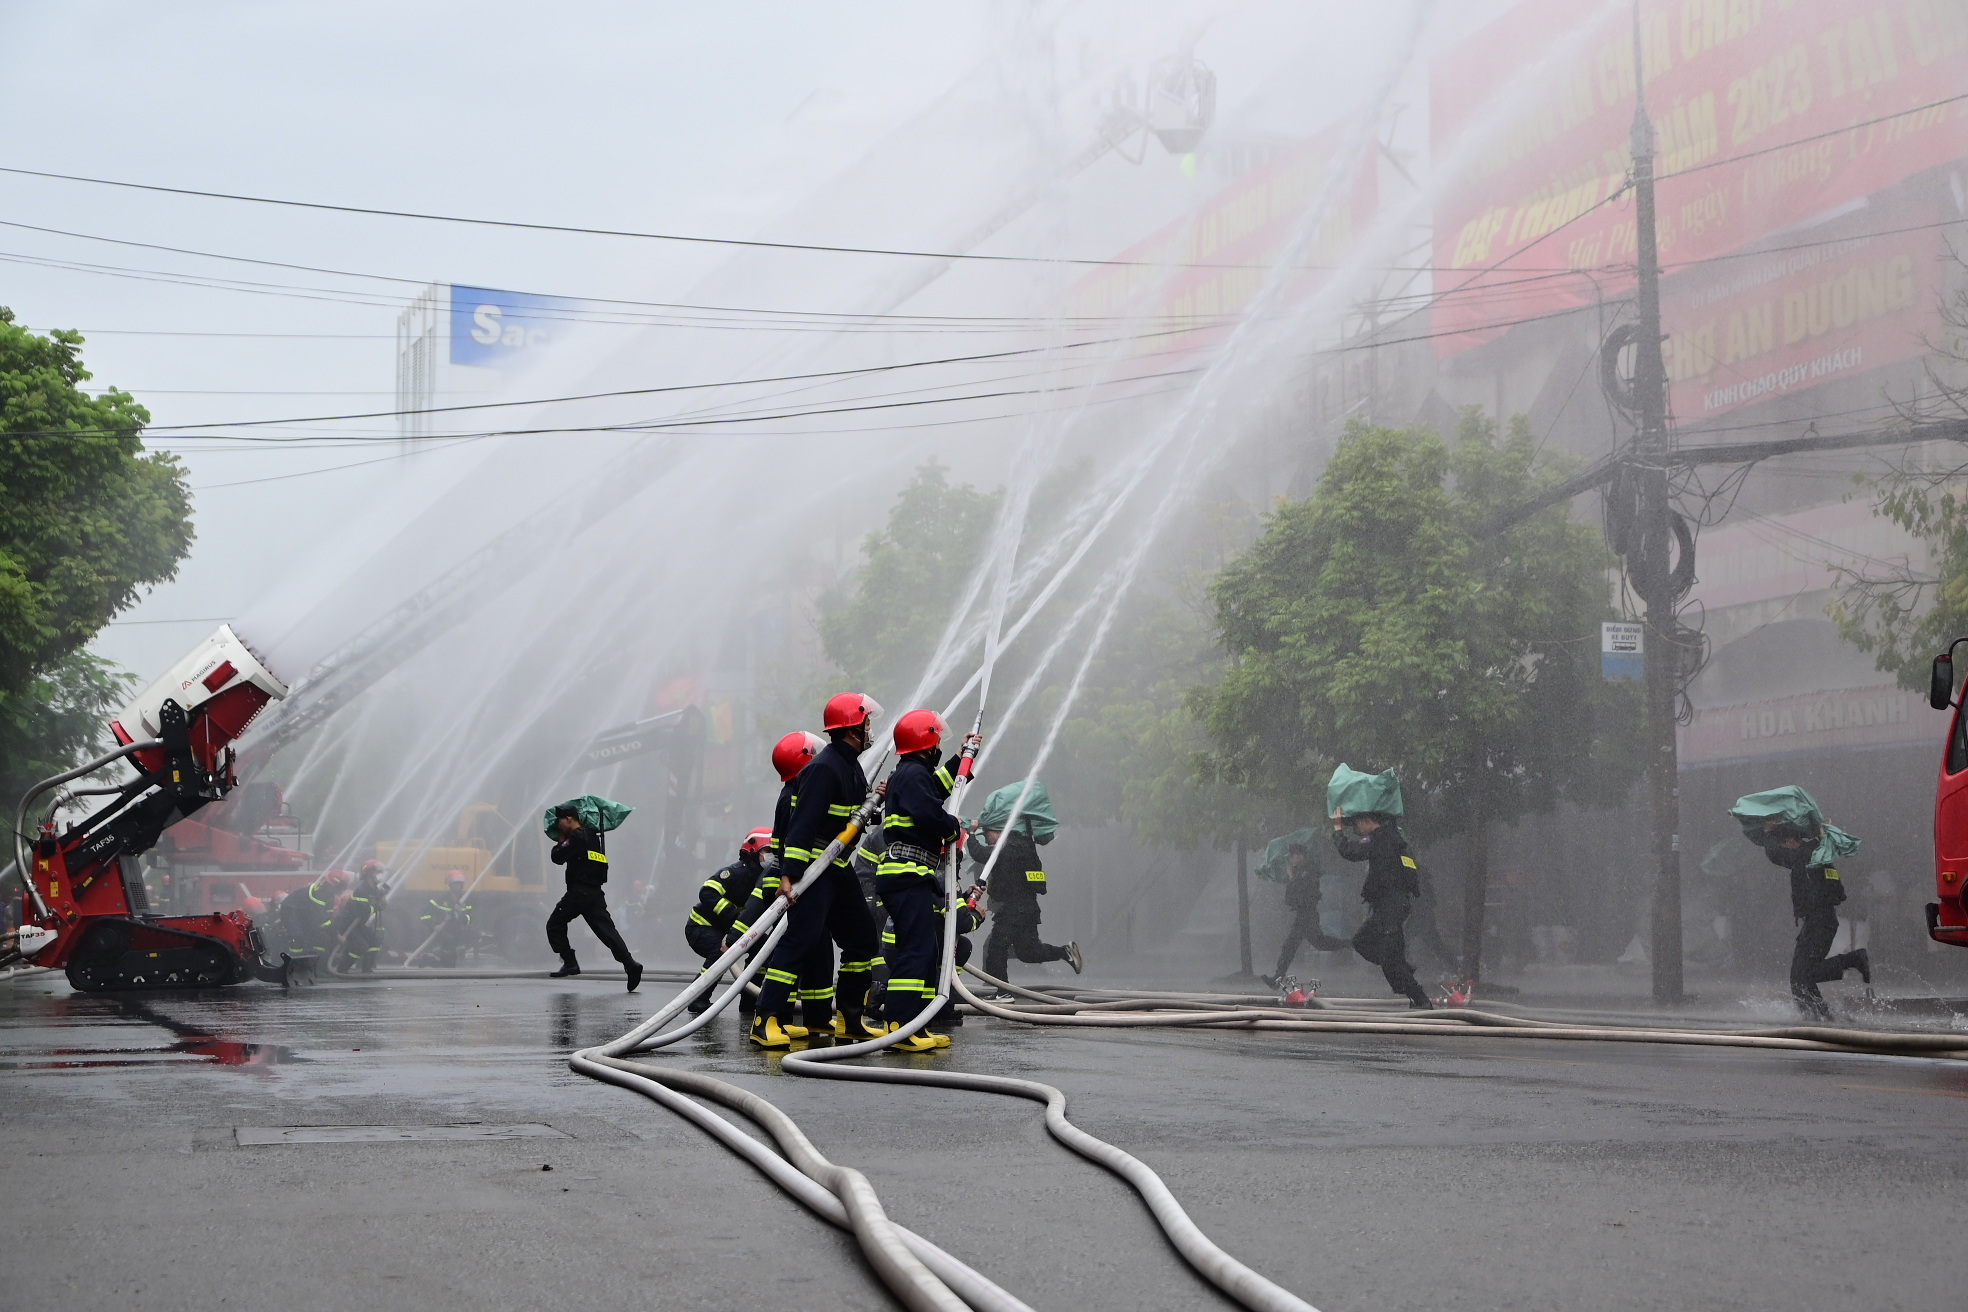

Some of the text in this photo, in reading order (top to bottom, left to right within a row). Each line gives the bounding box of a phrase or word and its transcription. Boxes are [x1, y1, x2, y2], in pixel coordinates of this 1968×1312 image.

[1726, 301, 1776, 365] AN
[1784, 254, 1915, 346] DƯƠNG
[1810, 346, 1863, 379] KHÁCH
[191, 660, 216, 682] MAGIRUS
[589, 740, 642, 761] VOLVO
[90, 834, 115, 853] TAF35
[20, 931, 46, 940] TAF35
